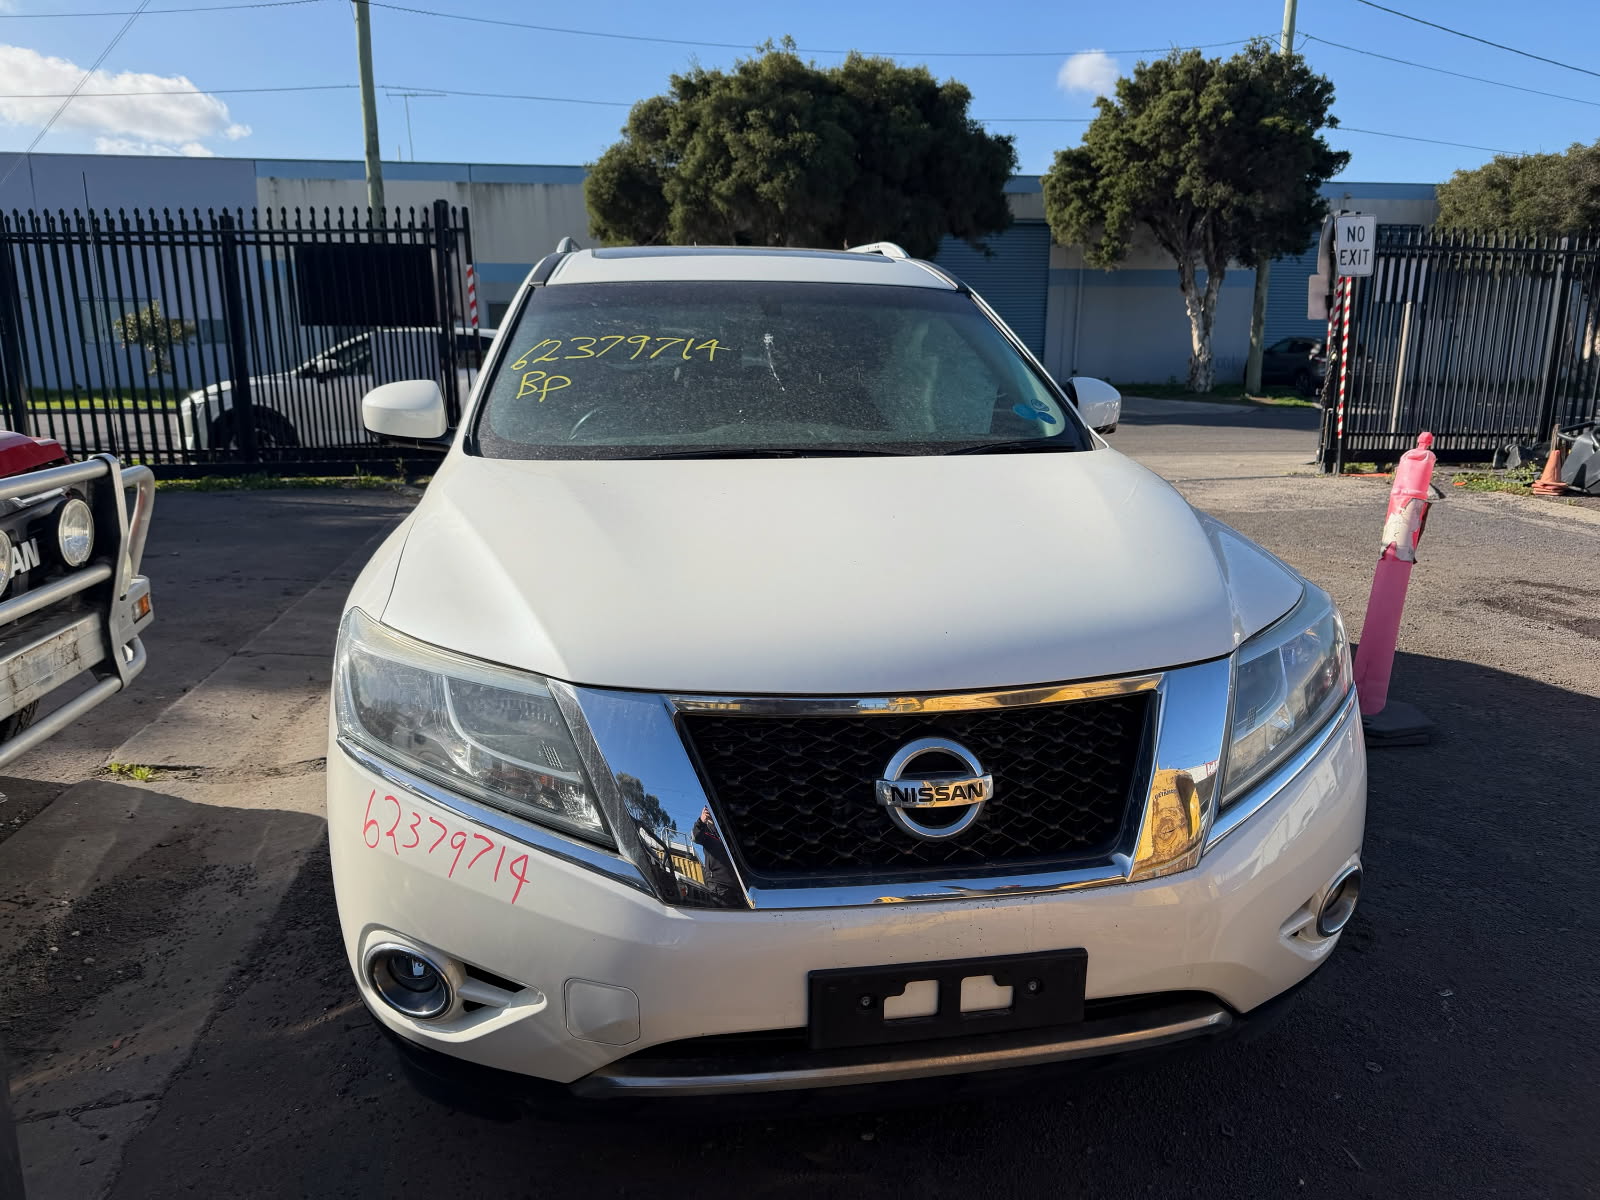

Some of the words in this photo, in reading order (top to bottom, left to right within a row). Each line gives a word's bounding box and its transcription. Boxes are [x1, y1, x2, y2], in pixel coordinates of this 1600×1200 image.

[1347, 226, 1365, 242] NO
[1340, 249, 1370, 266] EXIT
[511, 335, 731, 370] 62379714
[516, 371, 571, 402] BP
[890, 782, 983, 803] NISSAN
[363, 789, 530, 904] 62379714
